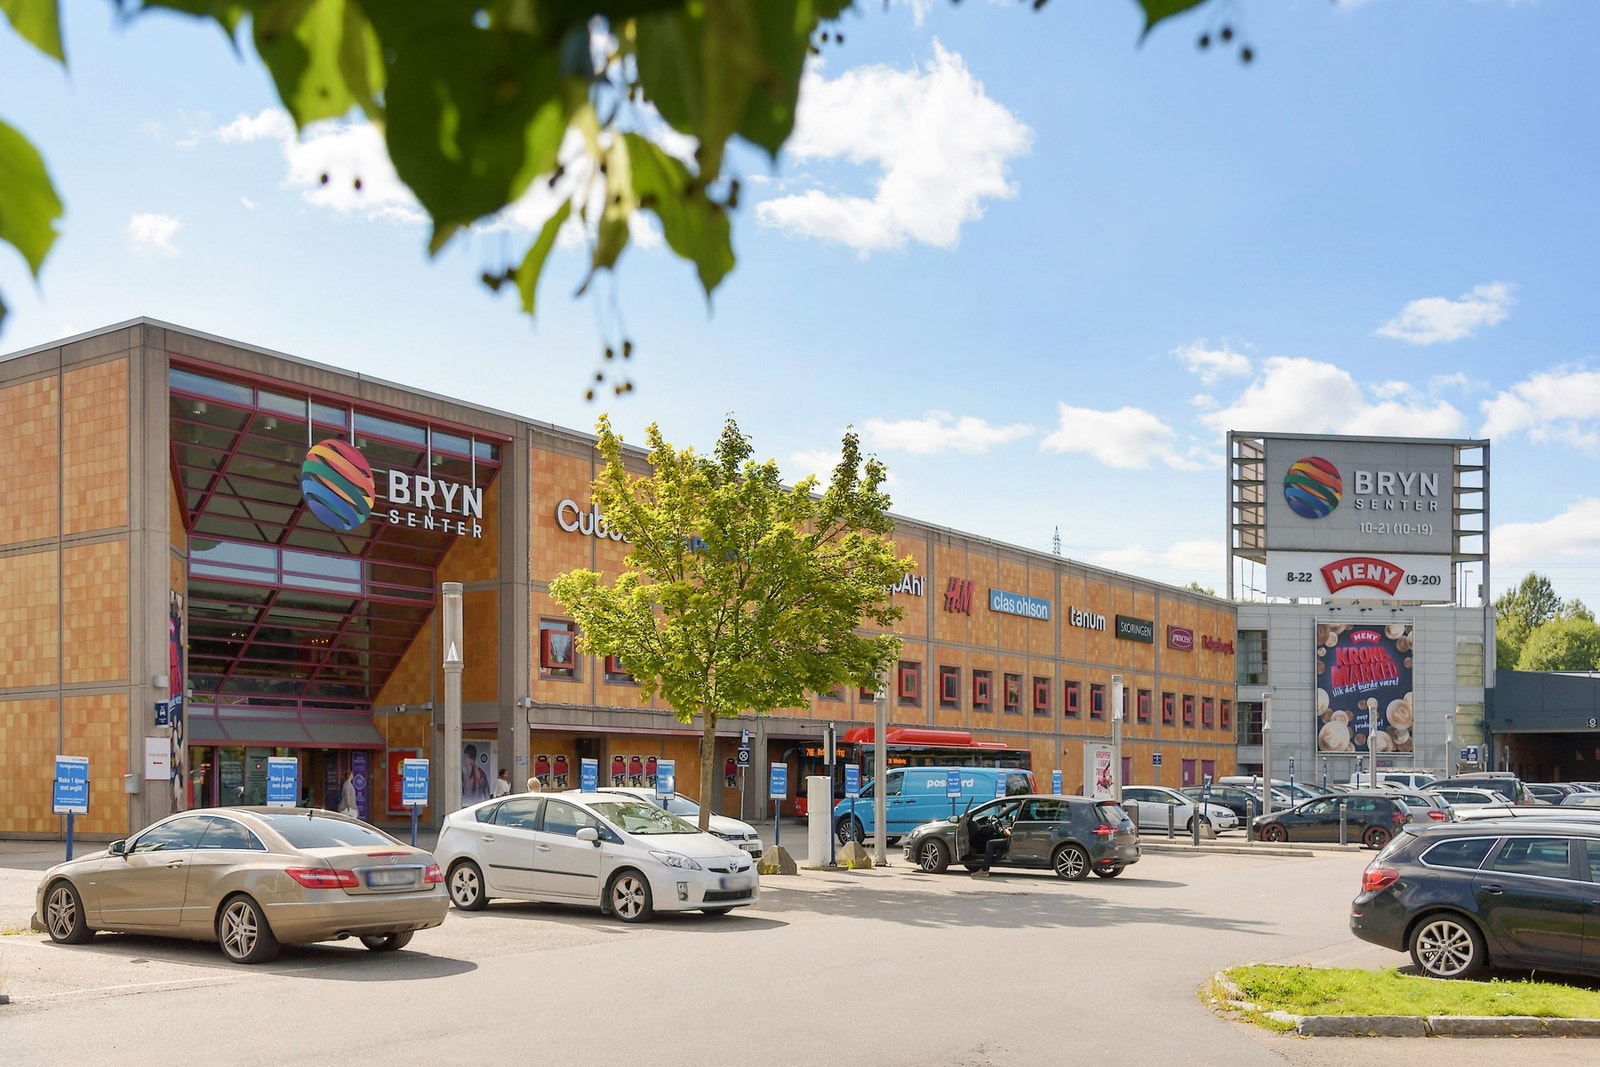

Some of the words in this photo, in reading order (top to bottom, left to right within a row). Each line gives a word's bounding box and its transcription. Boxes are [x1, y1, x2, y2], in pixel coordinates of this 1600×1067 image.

[389, 469, 483, 519] BRYN
[1354, 470, 1438, 497] BRYN
[1354, 499, 1438, 512] SENTER
[389, 509, 482, 538] SENTER
[1360, 522, 1390, 534] 10-21
[1393, 523, 1433, 536] (10-19)
[1287, 572, 1313, 582] 8-22
[1332, 563, 1397, 585] MENY
[1406, 574, 1441, 586] (9-20)
[944, 576, 975, 616] H&M
[993, 592, 1015, 611] clas
[1016, 597, 1048, 619] ohlson
[1070, 605, 1106, 631] tanum
[1120, 621, 1152, 637] SKORINGEN
[1353, 632, 1378, 641] MENY
[1331, 661, 1399, 689] MARKED
[1344, 684, 1356, 694] det
[1357, 680, 1379, 691] burde
[1379, 677, 1399, 687] være!
